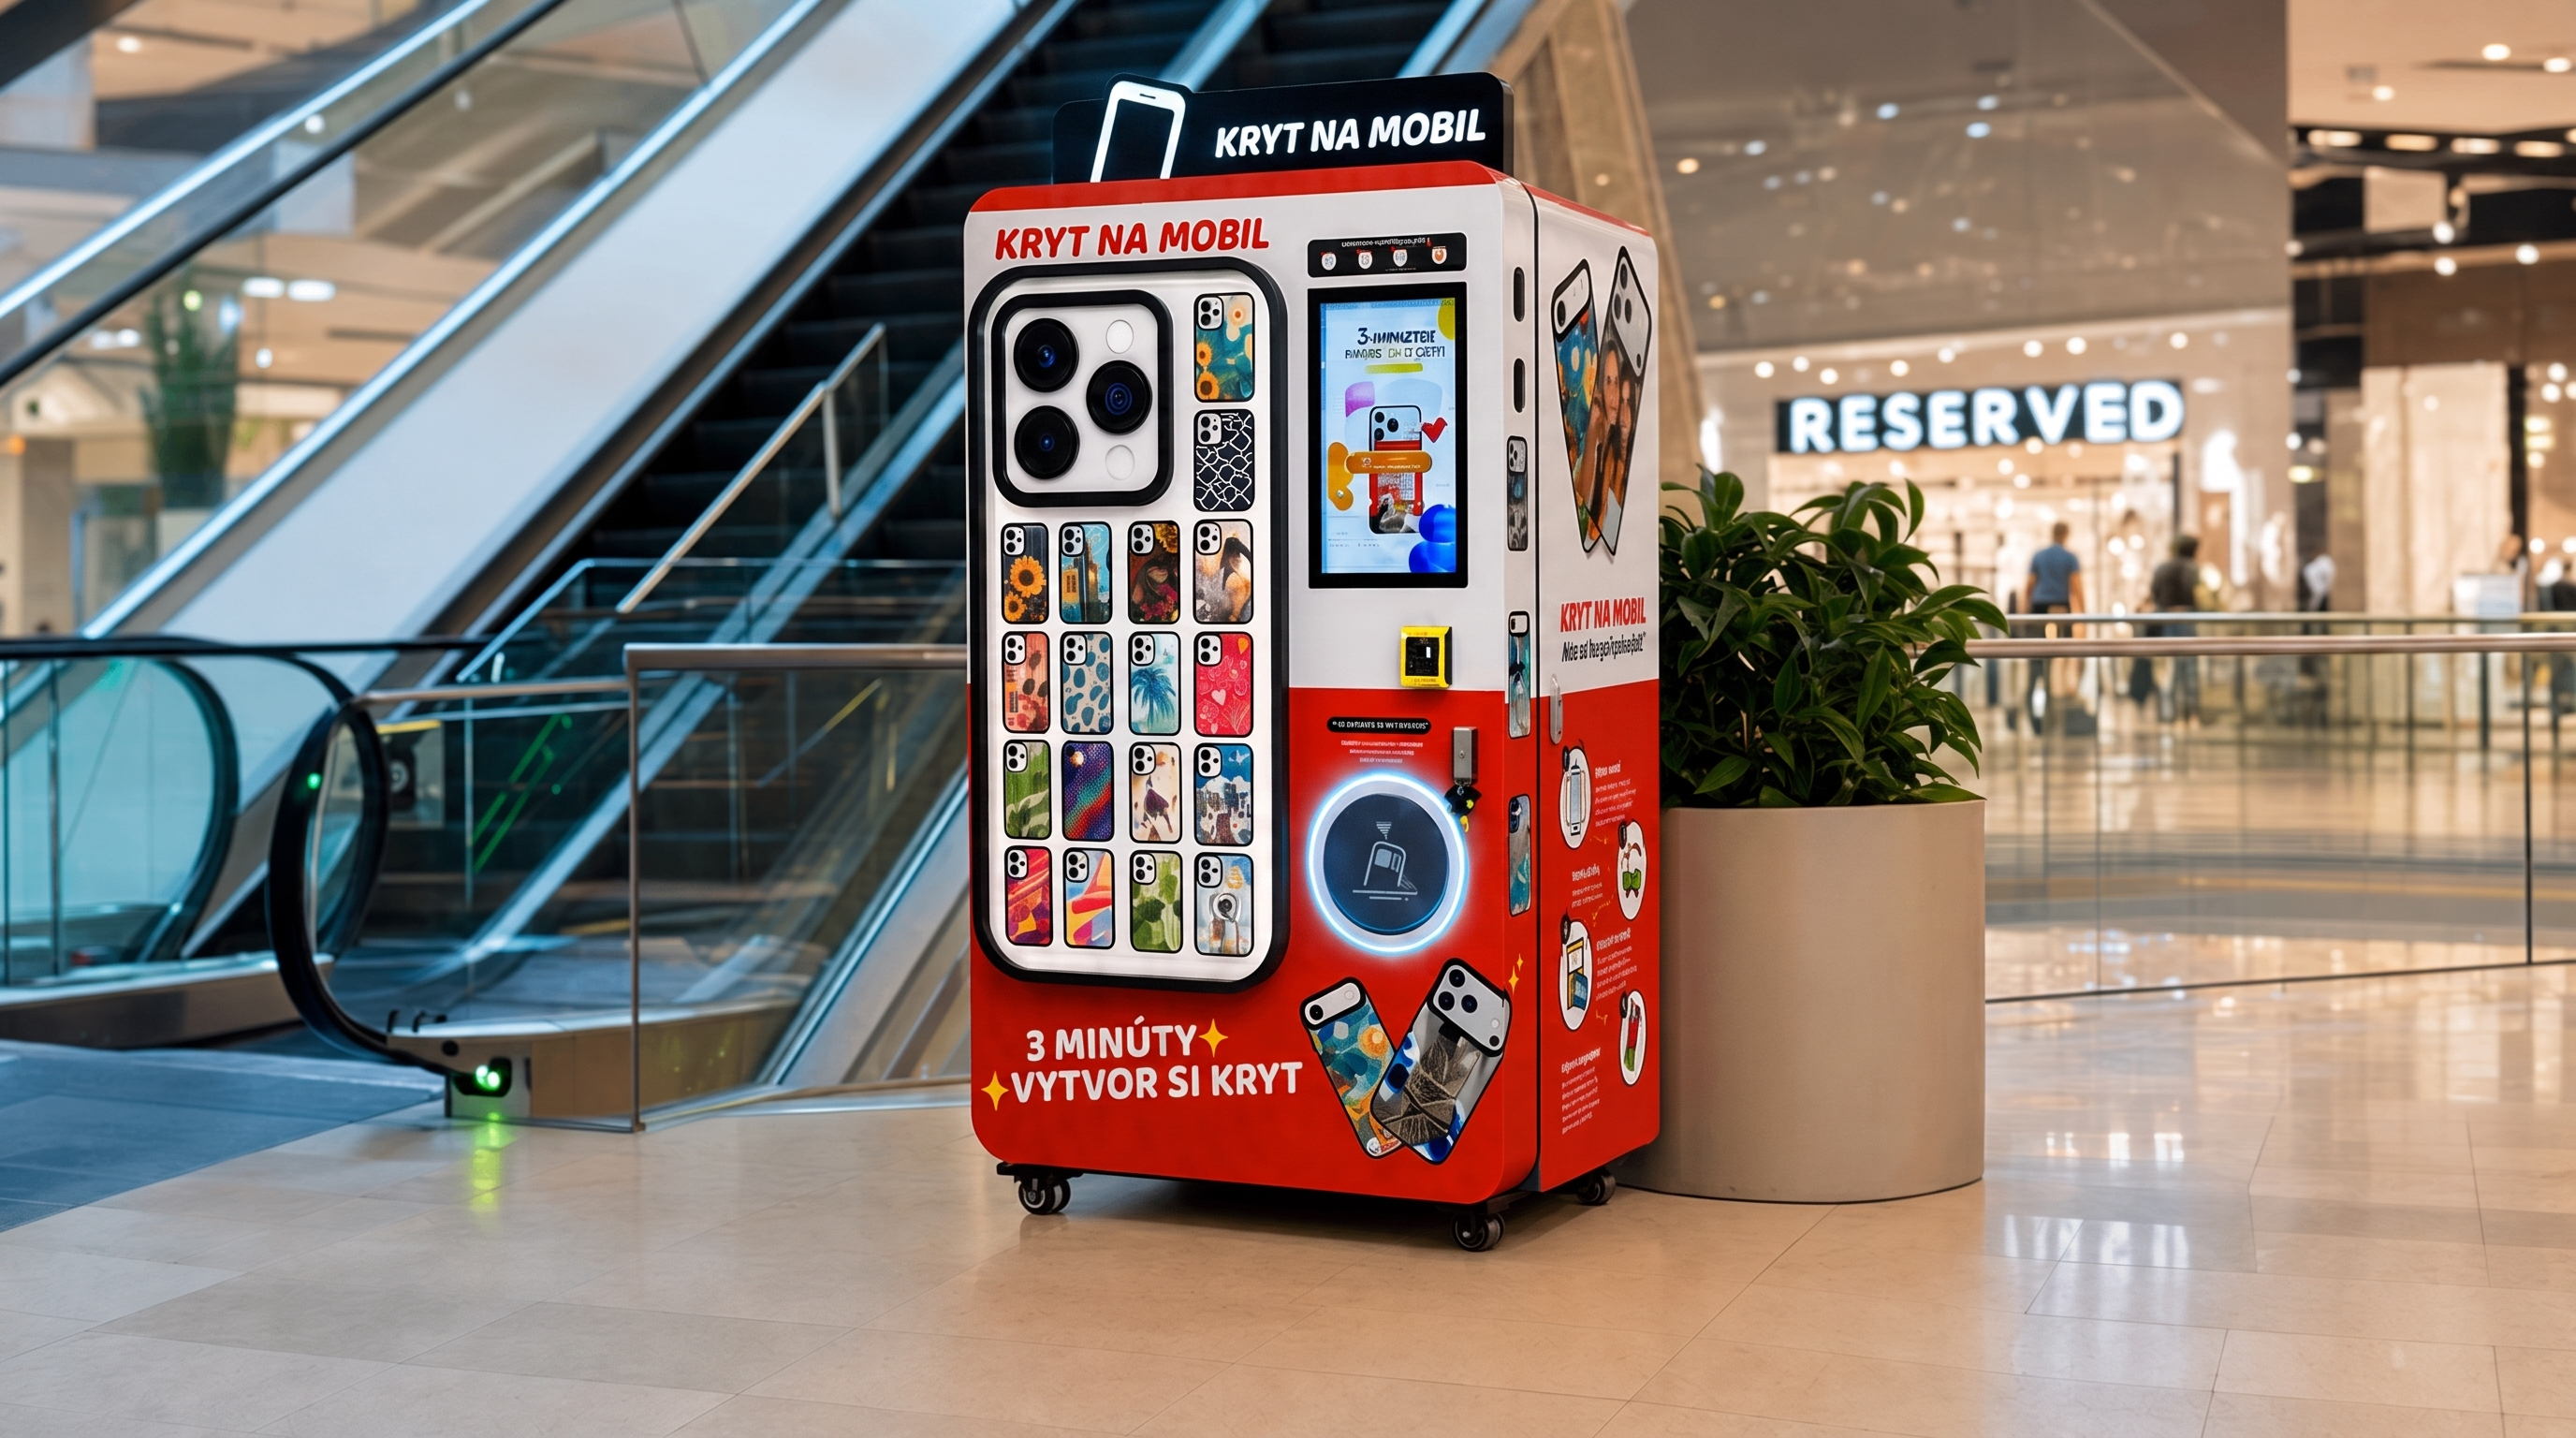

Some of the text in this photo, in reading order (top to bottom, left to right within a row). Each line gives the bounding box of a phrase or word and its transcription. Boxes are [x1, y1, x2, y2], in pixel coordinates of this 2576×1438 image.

[1214, 108, 1486, 158] KRYT NA MOBIL
[995, 217, 1269, 260] KRYT NA MOBIL
[1790, 379, 2186, 454] RESERVED
[1560, 597, 1647, 633] KRYT NA MOBIL
[1026, 1015, 1197, 1062] 3 MINÚTY
[1011, 1062, 1304, 1104] VYTVOR SI KRYT
